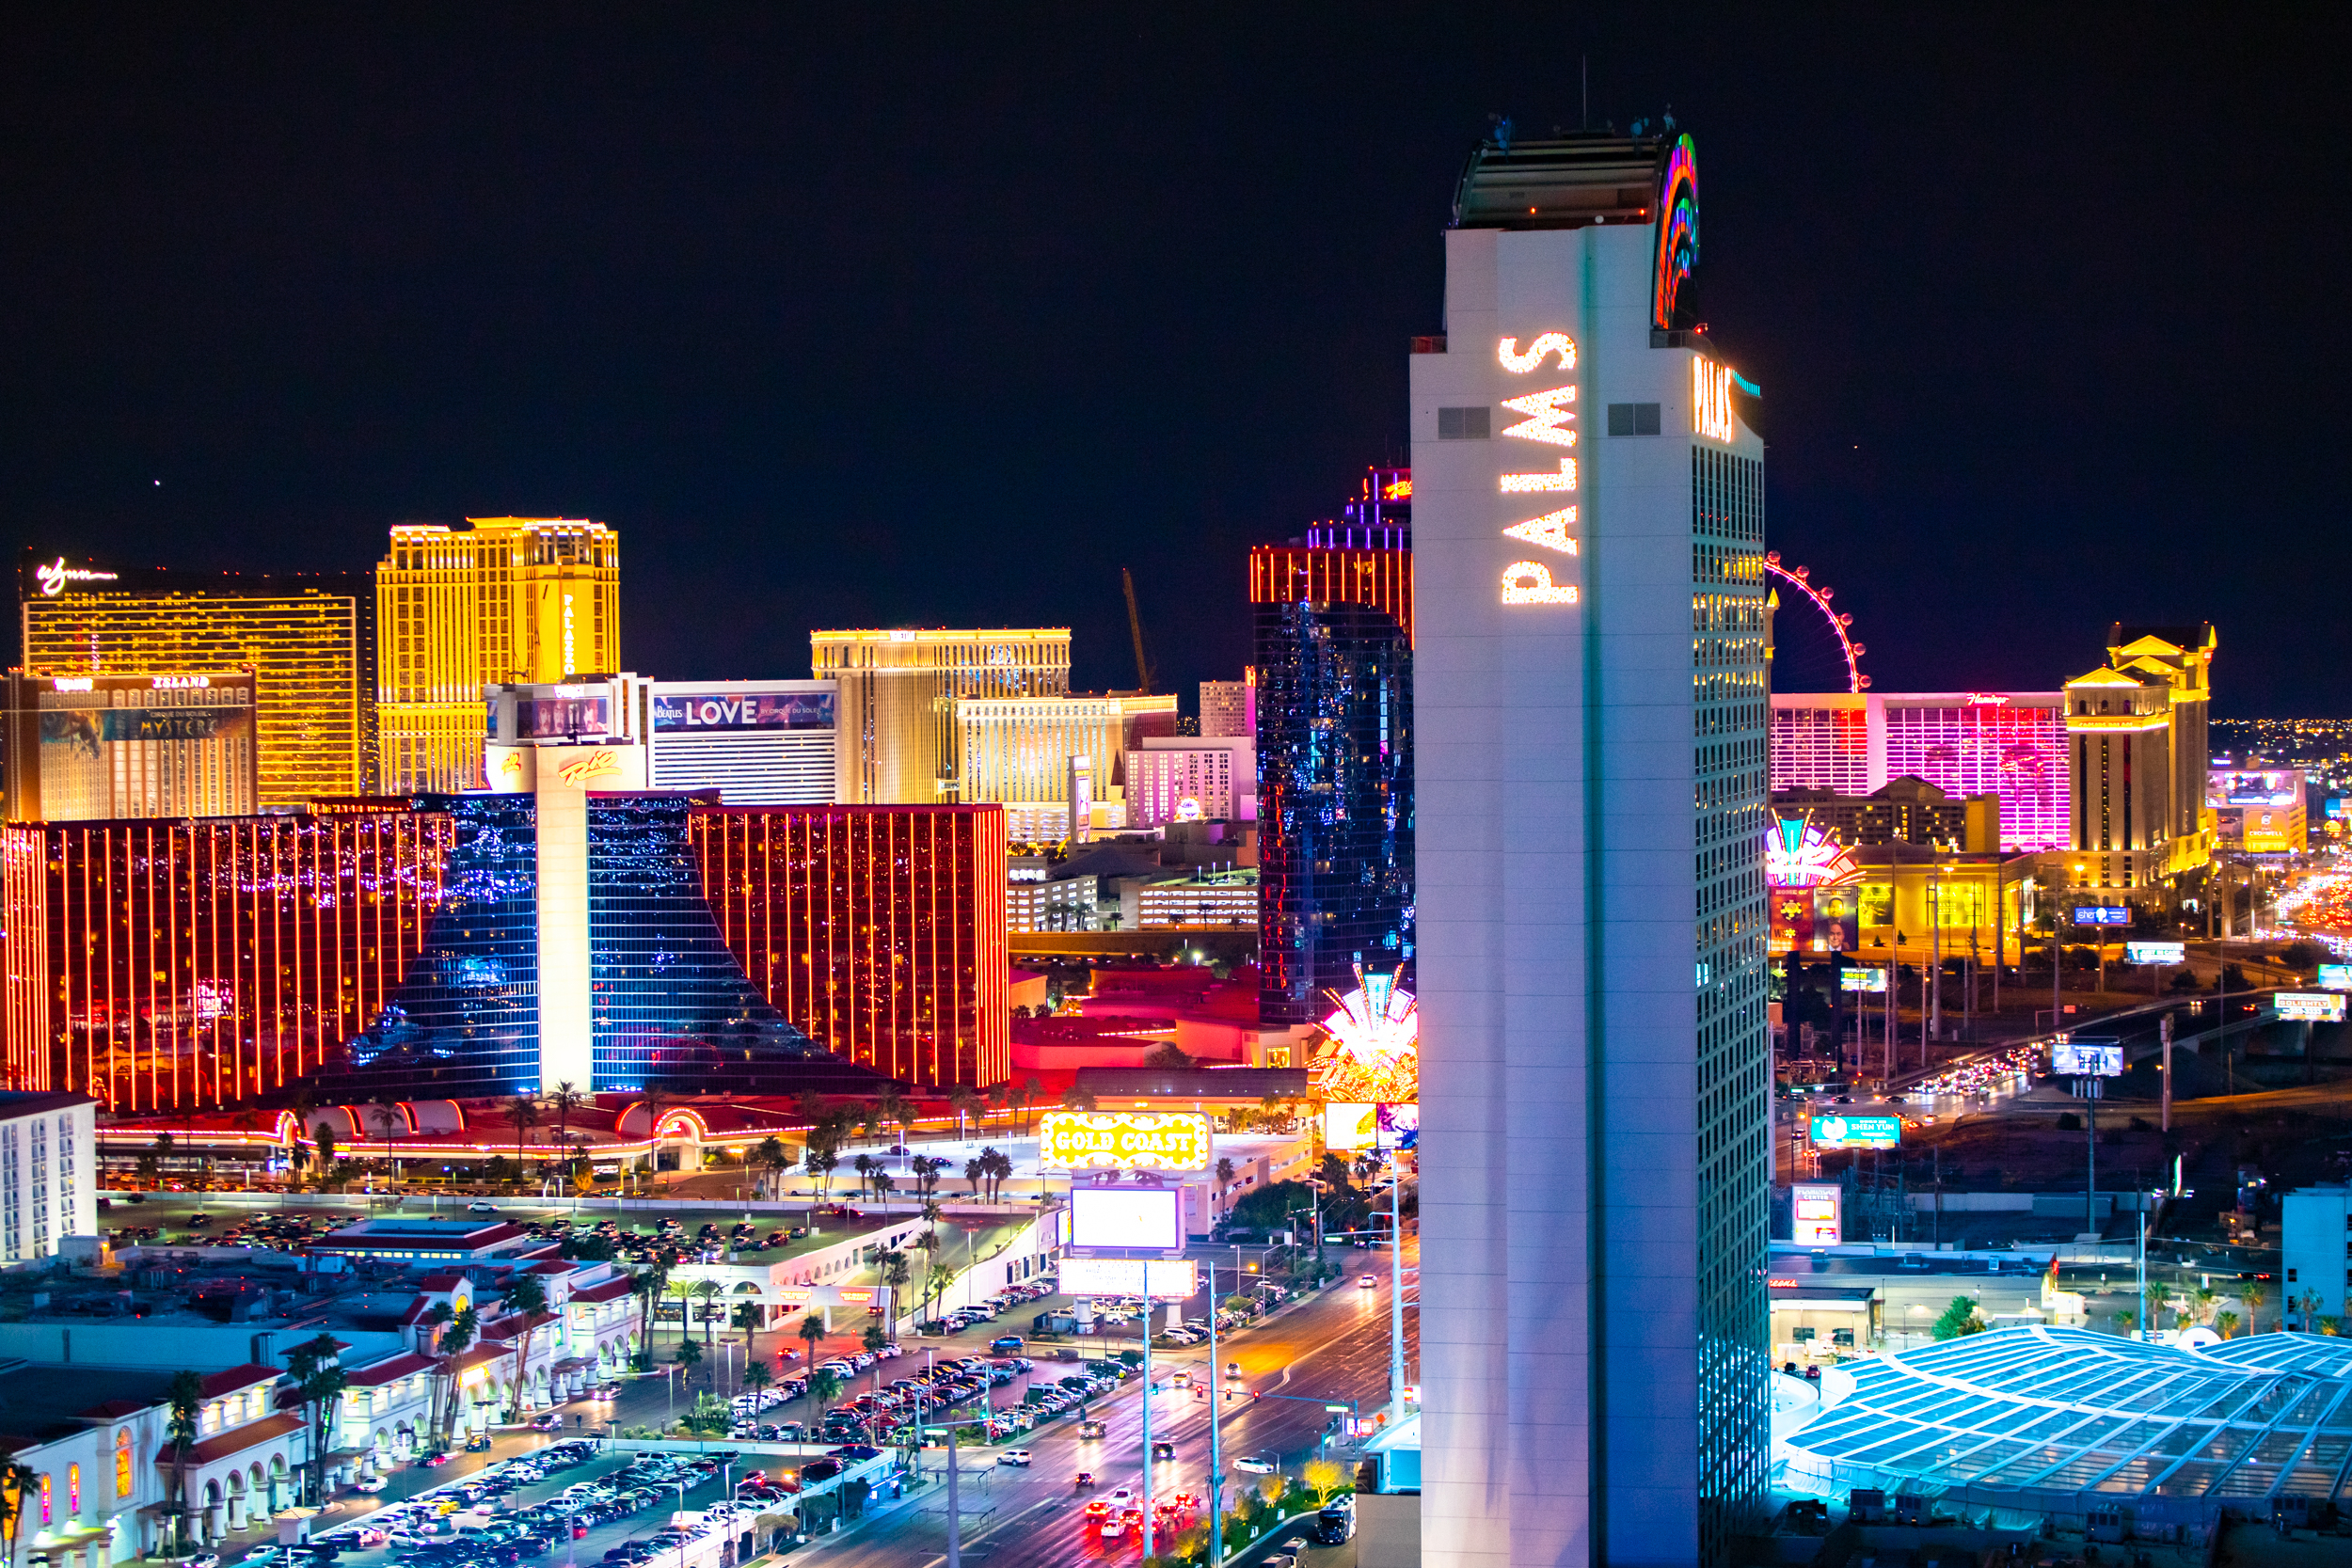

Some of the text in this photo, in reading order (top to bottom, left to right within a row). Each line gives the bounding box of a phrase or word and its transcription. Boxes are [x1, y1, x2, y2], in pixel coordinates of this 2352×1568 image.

[1498, 331, 1579, 605] PALMS
[564, 594, 576, 675] PALAZZO
[152, 676, 210, 689] ISLAND
[1966, 692, 2010, 707] Flamingo
[686, 701, 757, 725] LOVE
[769, 707, 791, 716] CIRQUE
[1055, 1132, 1193, 1151] GOLD COAST
